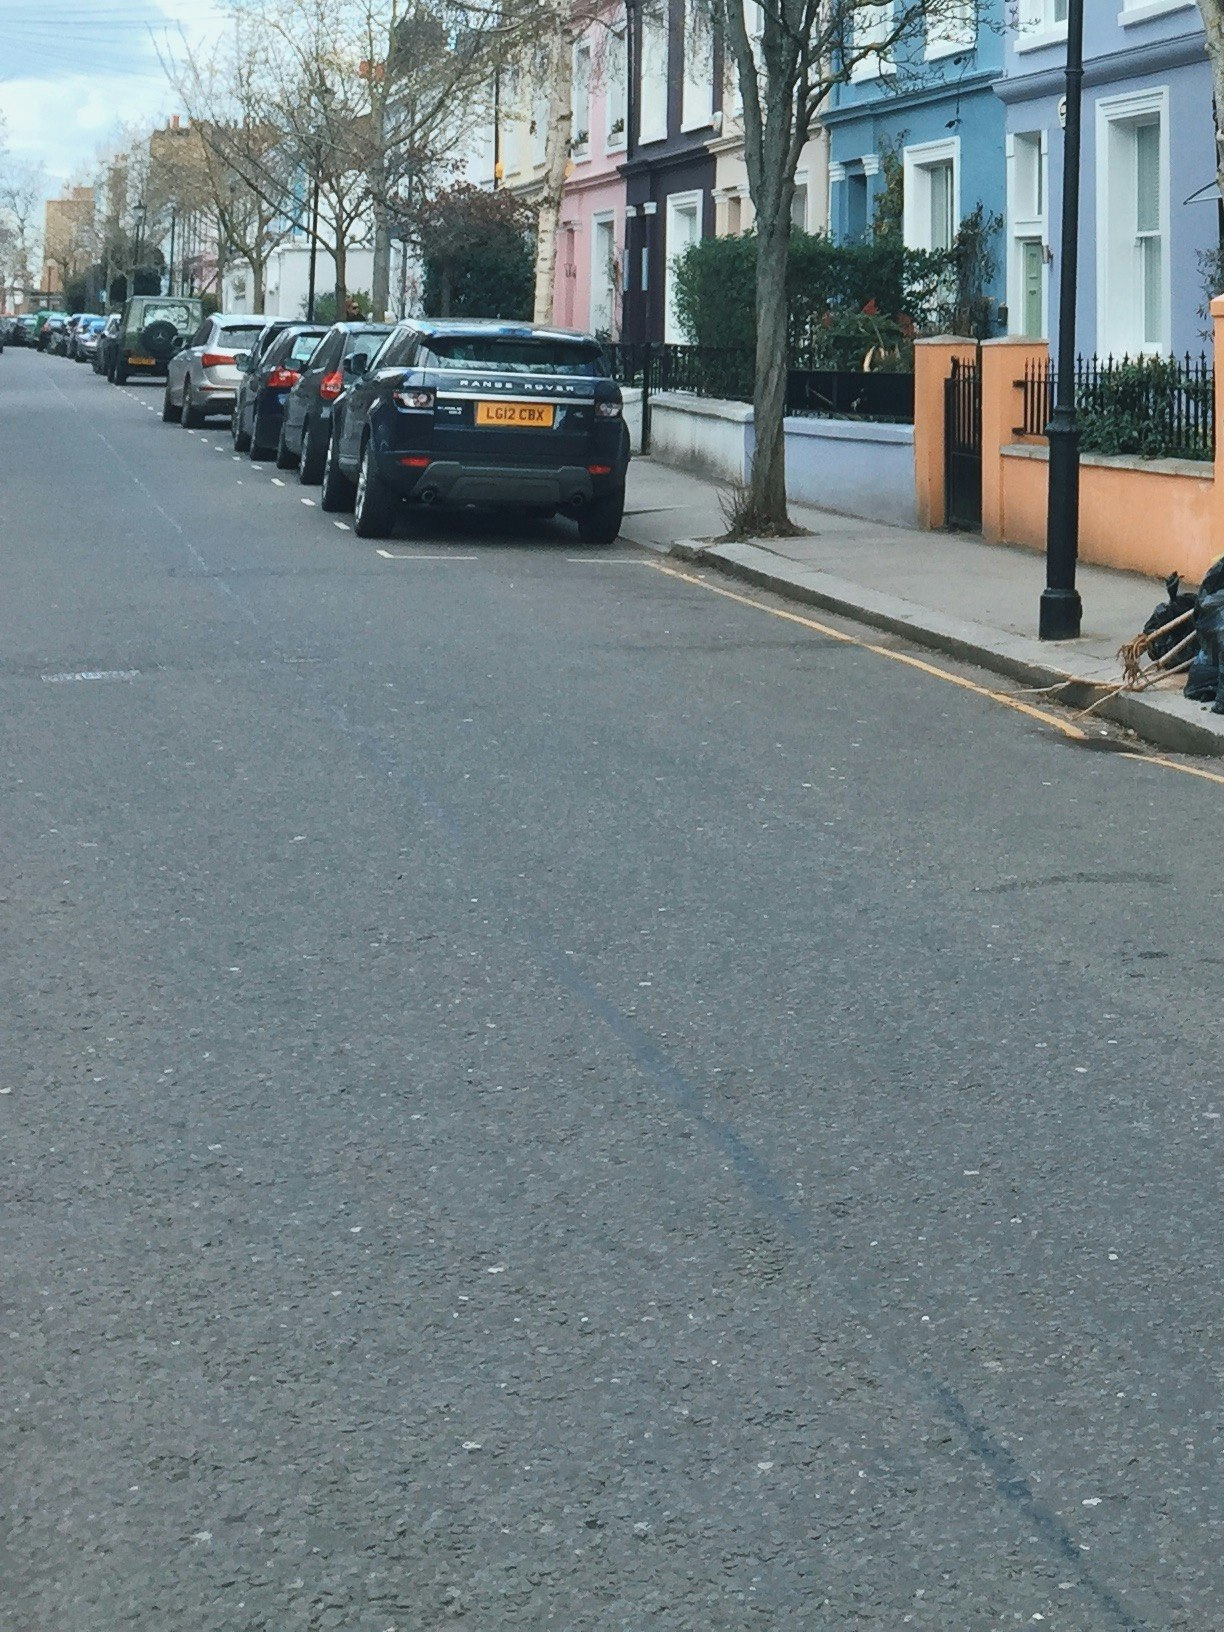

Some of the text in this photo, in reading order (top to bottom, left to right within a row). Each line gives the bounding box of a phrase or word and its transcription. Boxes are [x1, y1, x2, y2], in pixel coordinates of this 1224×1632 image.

[459, 379, 575, 392] RANGE ROVER
[486, 406, 545, 422] LG12 CBX
